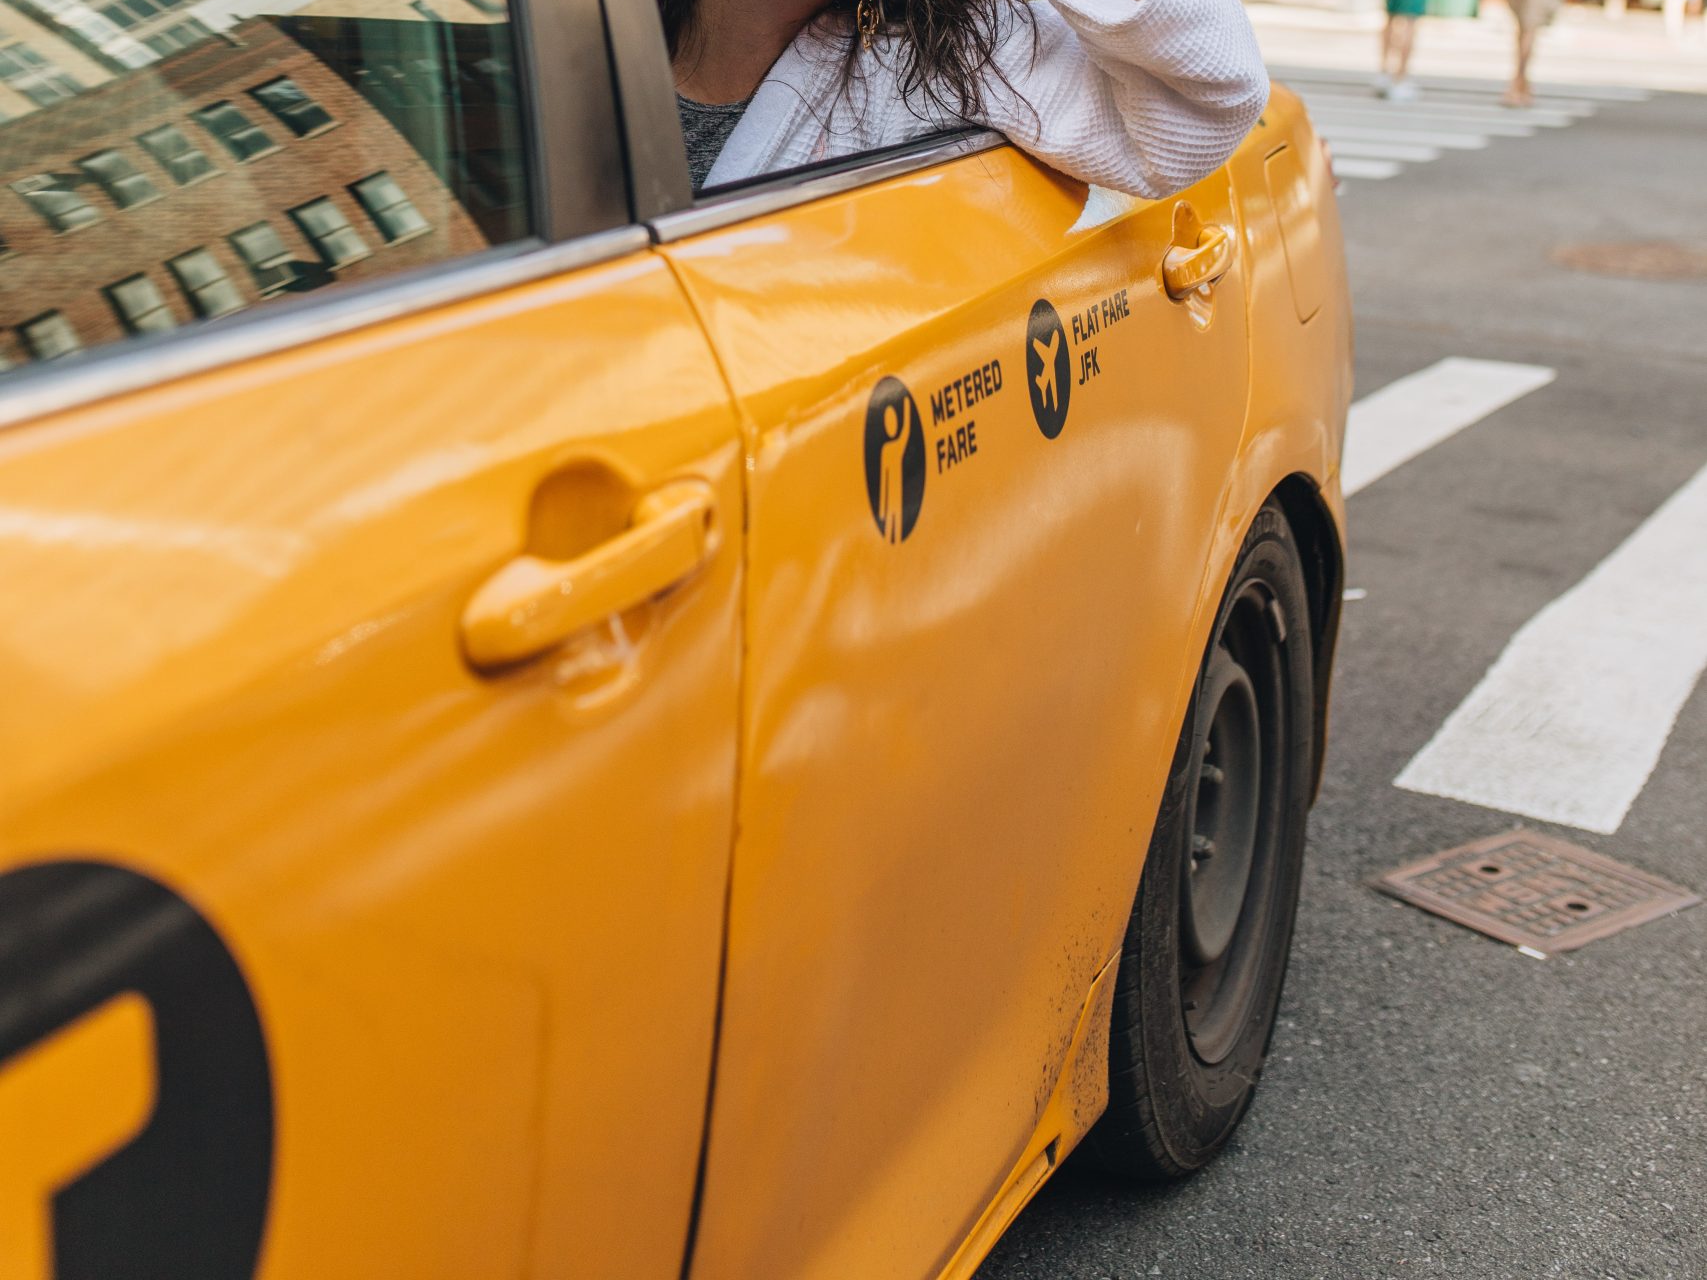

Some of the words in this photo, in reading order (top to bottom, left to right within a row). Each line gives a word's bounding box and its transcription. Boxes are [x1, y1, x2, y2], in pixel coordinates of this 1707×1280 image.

[1071, 304, 1100, 346] FLAT
[1101, 288, 1130, 329] FARE
[930, 359, 1003, 427] METERED
[1079, 346, 1101, 386] JFK
[936, 421, 978, 475] FARE
